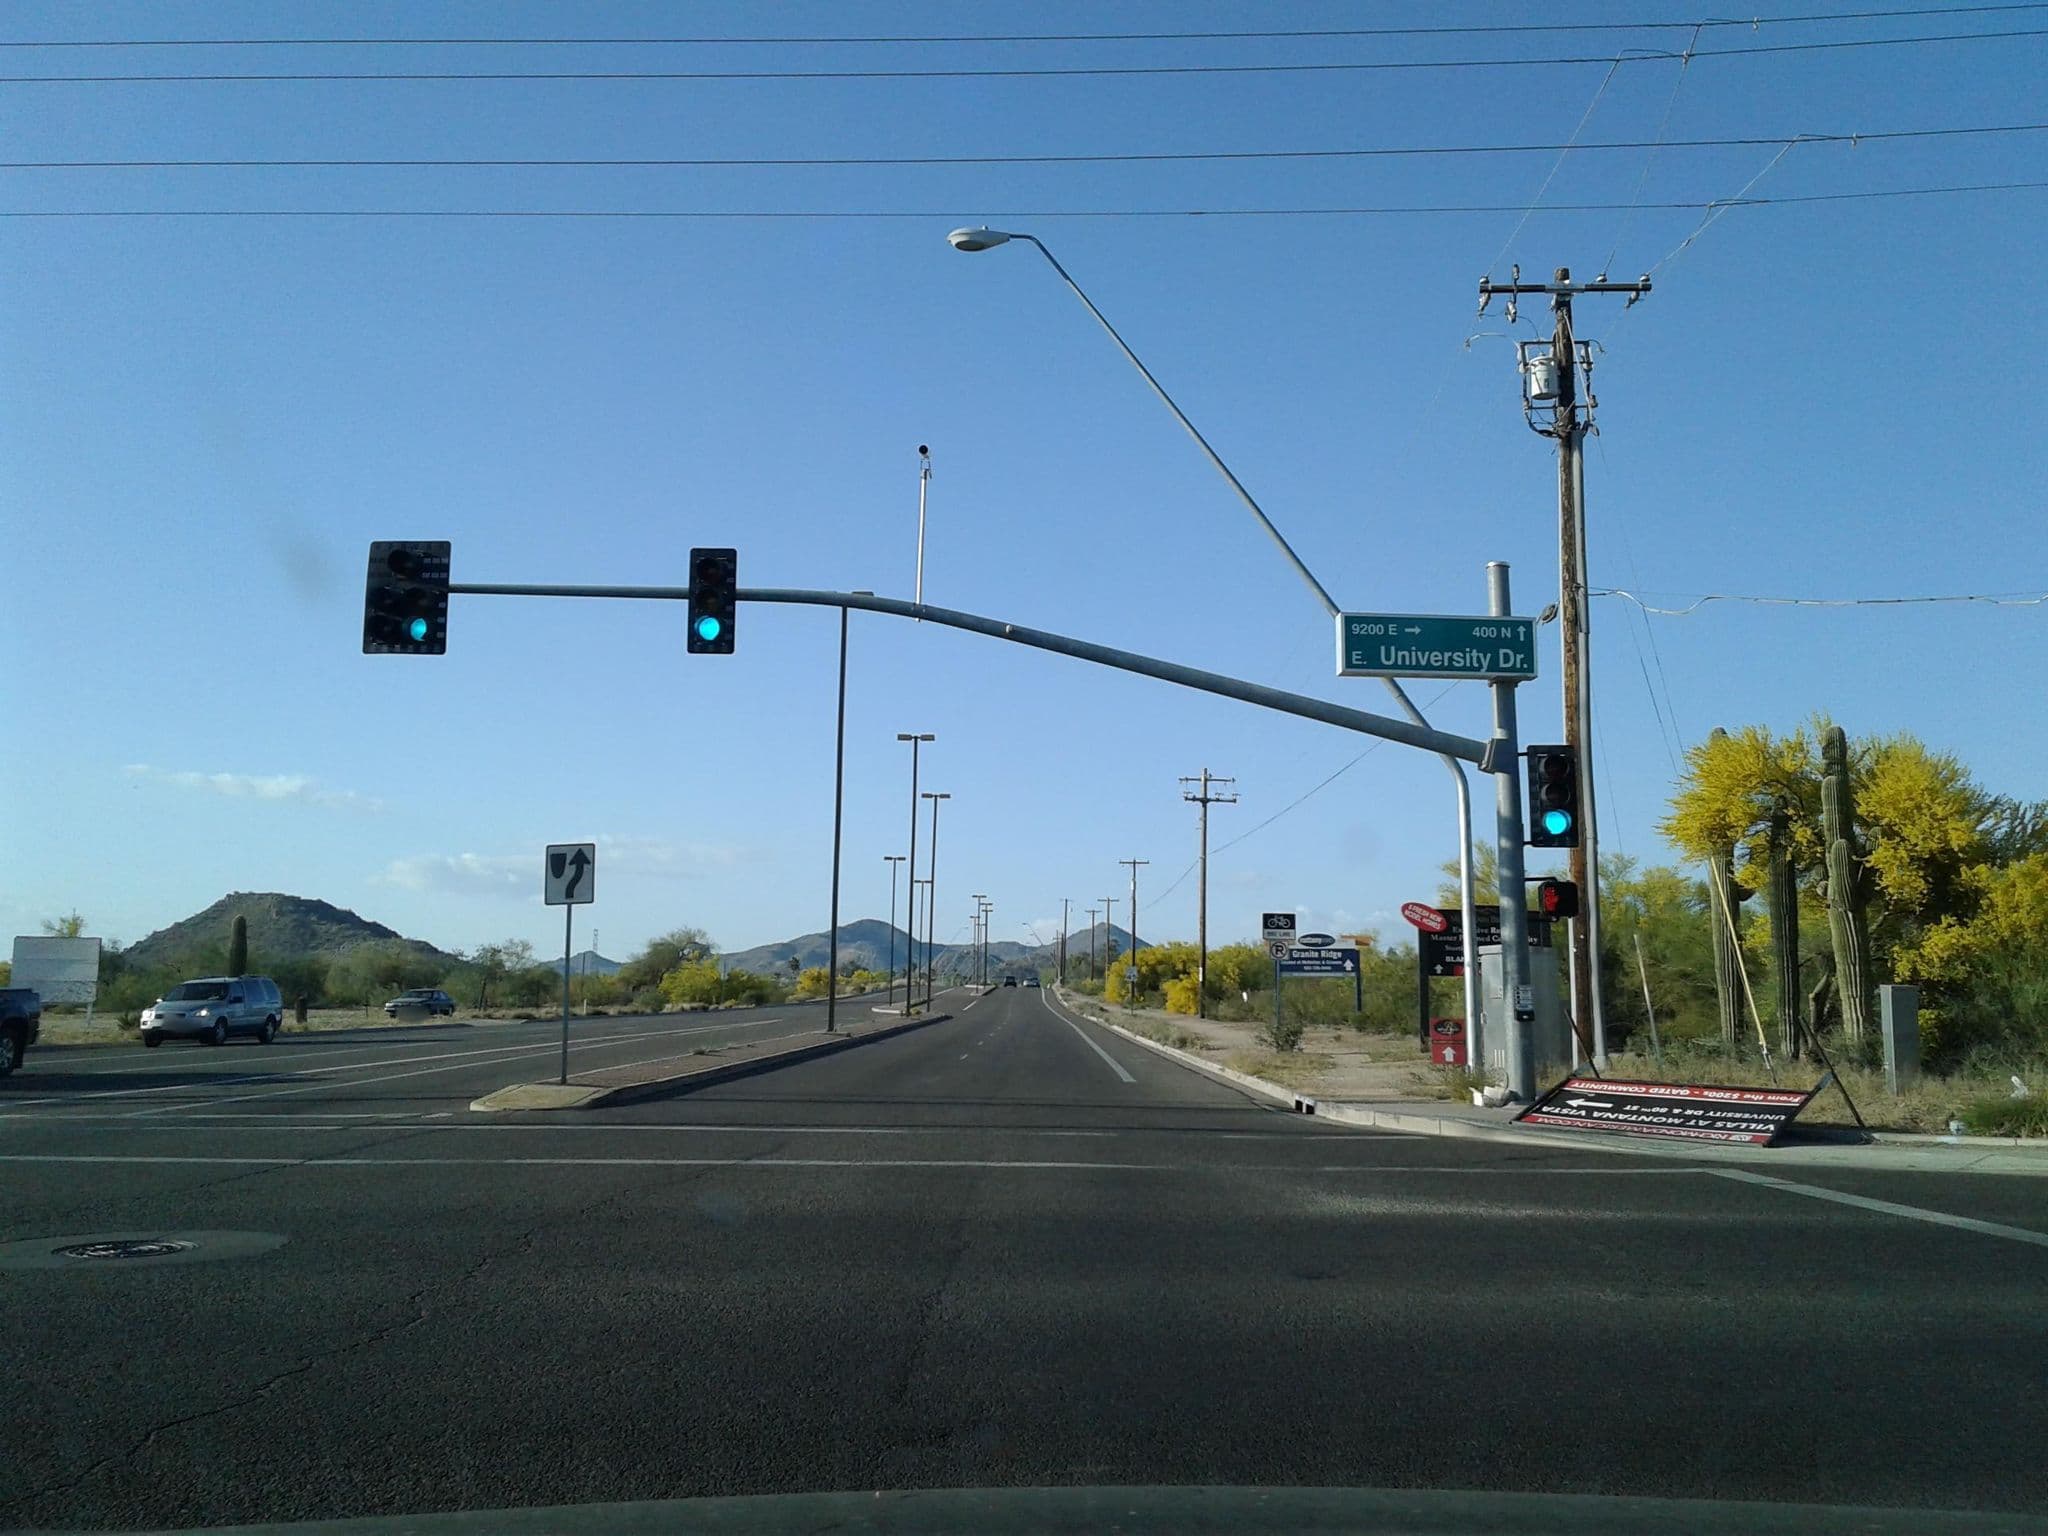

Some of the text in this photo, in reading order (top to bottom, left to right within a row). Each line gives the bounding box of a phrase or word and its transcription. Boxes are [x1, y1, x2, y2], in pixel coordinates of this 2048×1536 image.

[1351, 623, 1398, 636] 9200 E
[1472, 626, 1512, 639] 400 N
[1352, 645, 1529, 673] E. University Dr.
[1569, 1081, 1646, 1093] COMMUNITY
[1648, 1086, 1690, 1096] GATED
[1743, 1093, 1764, 1101] the
[1767, 1094, 1802, 1103] From
[1622, 1104, 1641, 1112] ST
[1685, 1108, 1705, 1116] DR
[1541, 1105, 1776, 1131] VILLAS AT MONTANA VISTA
[1705, 1110, 1787, 1121] UNIVERSITY
